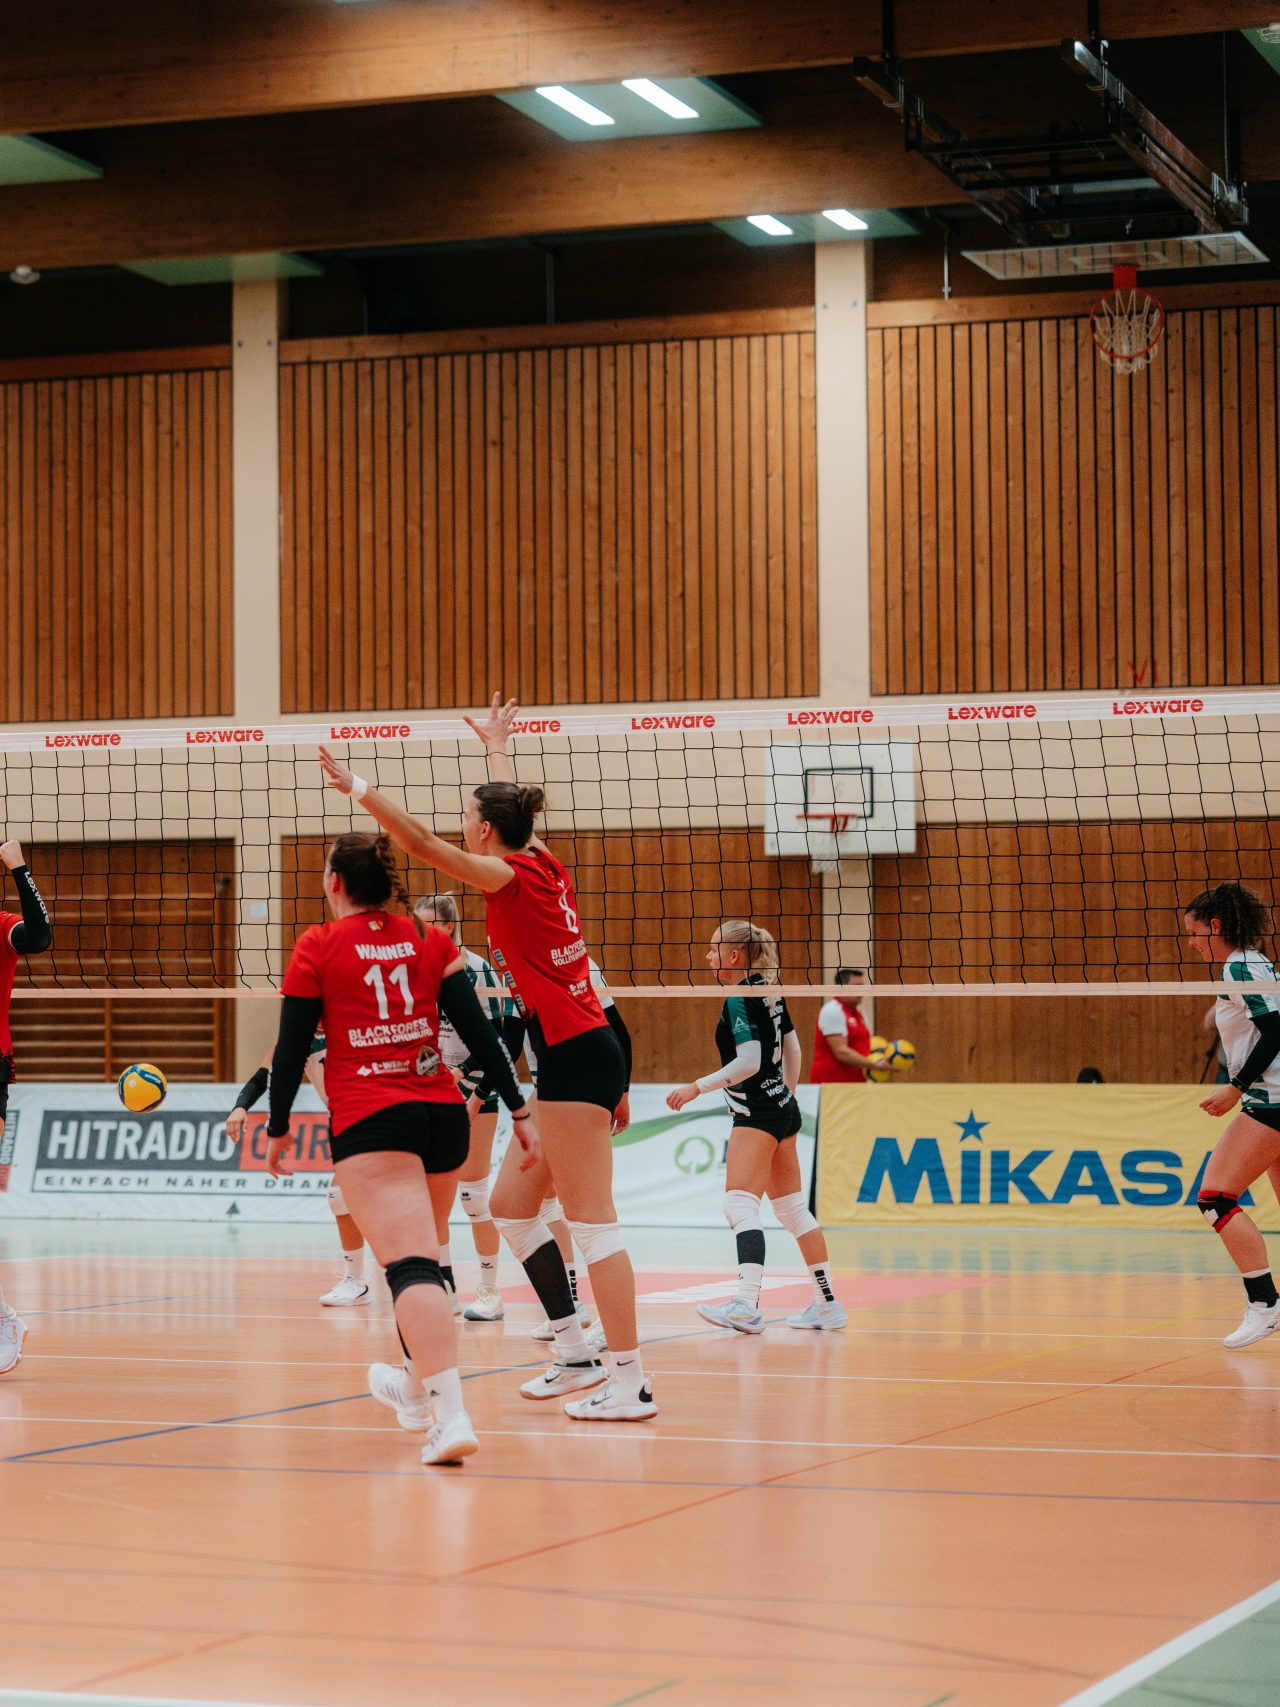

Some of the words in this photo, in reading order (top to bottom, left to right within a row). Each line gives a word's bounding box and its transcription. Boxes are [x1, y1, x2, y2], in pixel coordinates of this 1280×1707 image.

[948, 704, 1037, 720] Lexware
[1113, 699, 1204, 715] Lexware
[631, 714, 716, 731] Lexware
[787, 709, 874, 726] Lexware
[330, 724, 411, 739] Lexware
[512, 720, 561, 733] ware
[45, 733, 120, 749] Lexware
[186, 728, 264, 744] Lexware
[354, 941, 417, 960] WANNER
[363, 963, 415, 1019] 11
[348, 1024, 391, 1041] BLACK
[390, 1016, 429, 1035] FOREST
[46, 1120, 236, 1162] HITRADIO
[44, 1175, 150, 1187] EINFACH
[166, 1173, 248, 1188] NÄHER
[264, 1177, 329, 1189] DRAN
